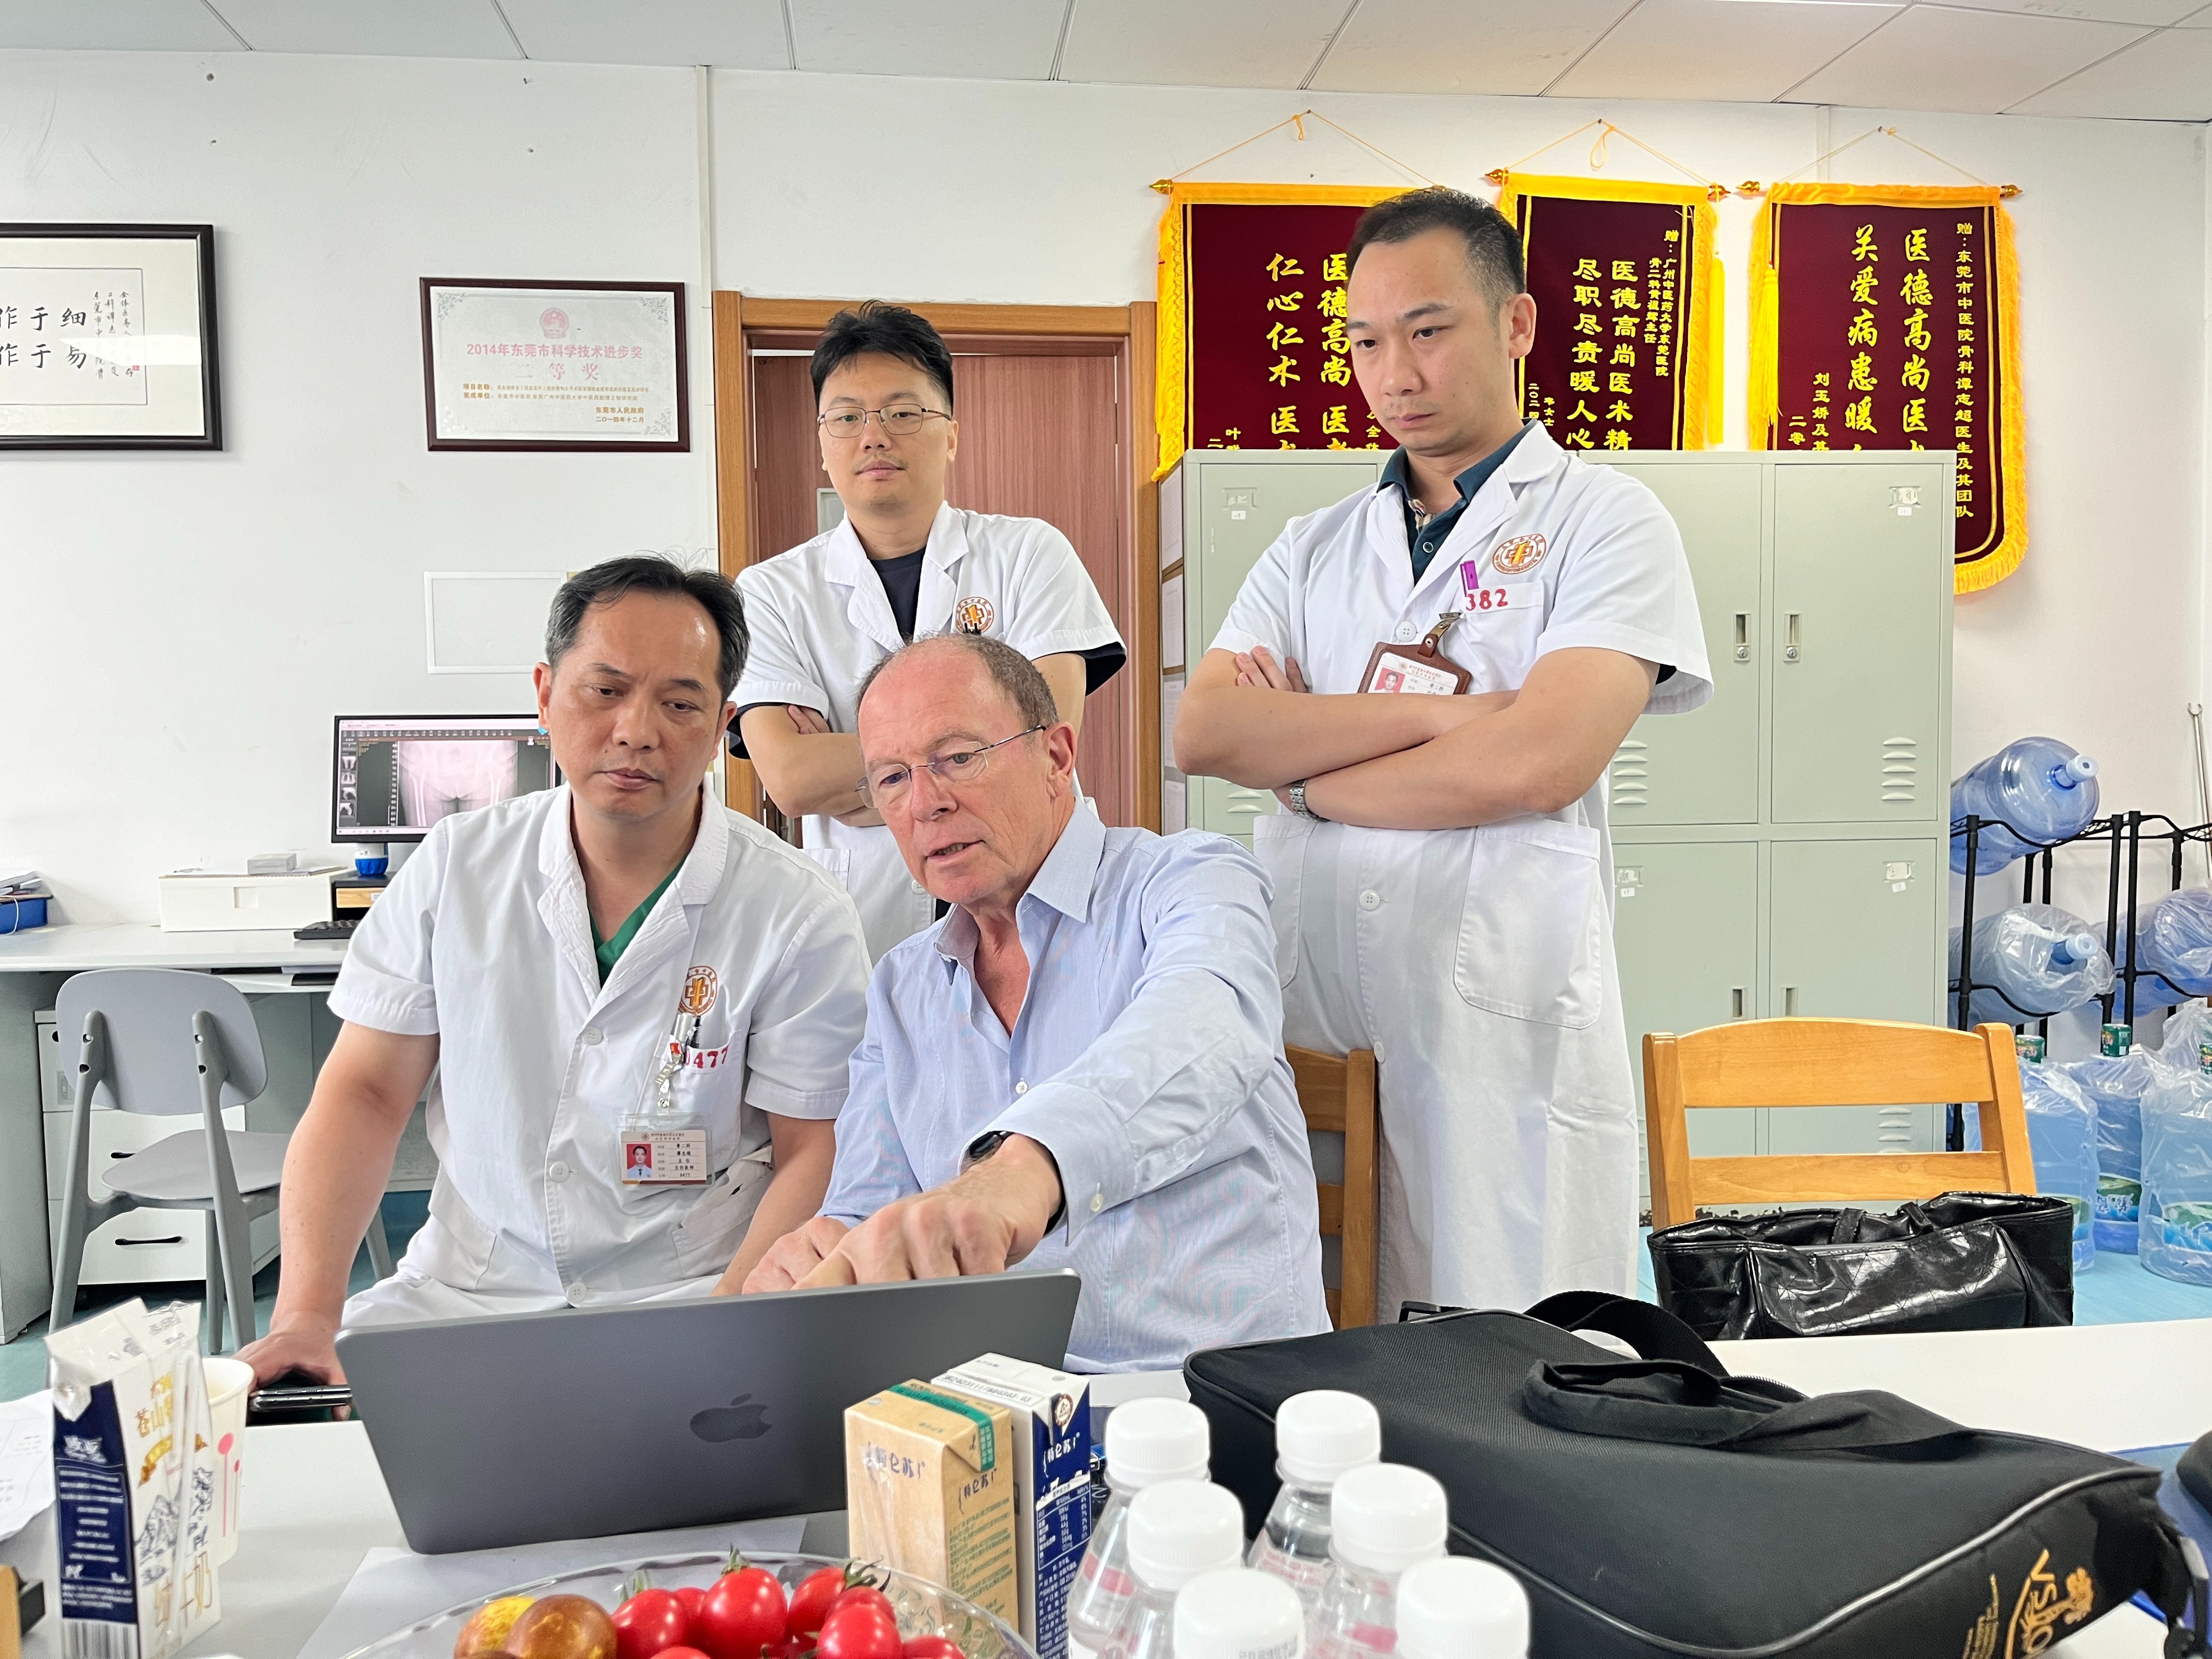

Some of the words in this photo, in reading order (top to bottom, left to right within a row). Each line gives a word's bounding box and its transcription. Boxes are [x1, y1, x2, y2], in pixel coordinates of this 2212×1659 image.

[467, 343, 643, 359] 2014年东莞市科学技术进步奖
[1566, 259, 1604, 449] 尽职尽责暖人心
[1601, 261, 1642, 451] 医德高尚医术精
[1845, 224, 1879, 452] 关爱病患暖
